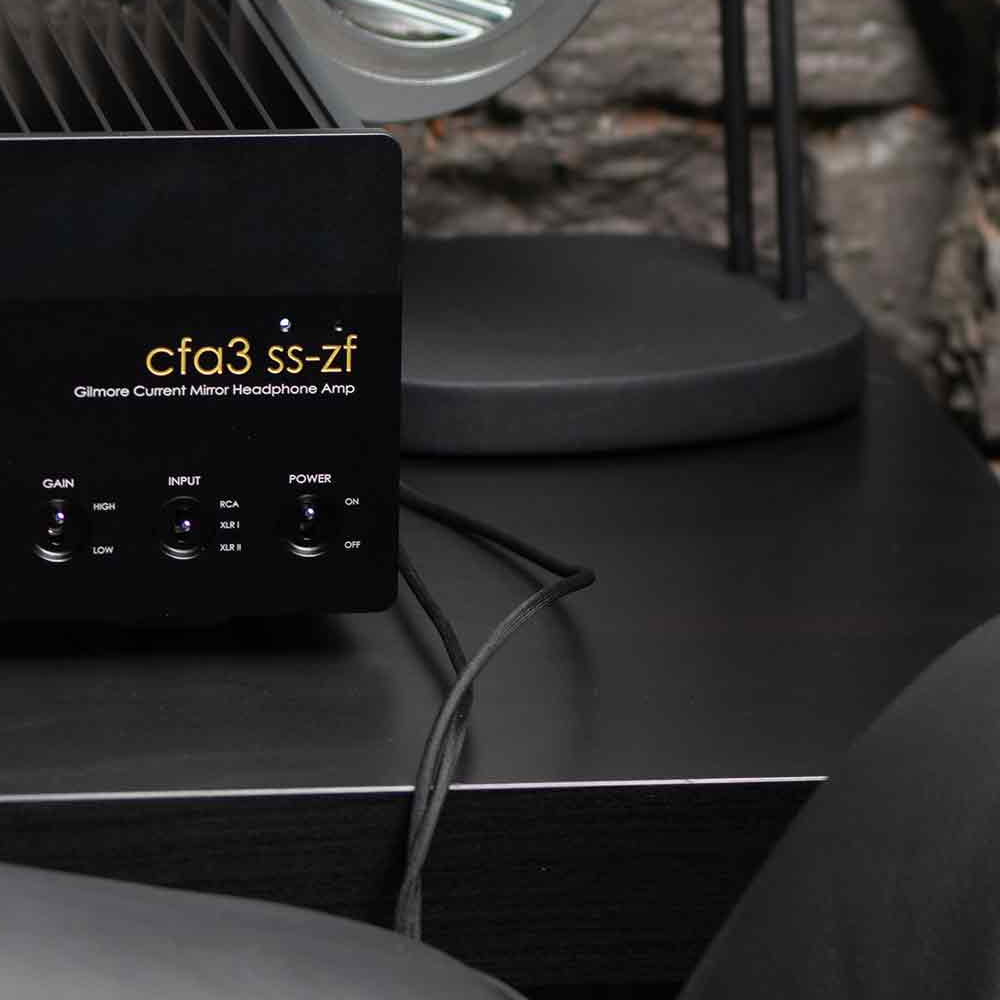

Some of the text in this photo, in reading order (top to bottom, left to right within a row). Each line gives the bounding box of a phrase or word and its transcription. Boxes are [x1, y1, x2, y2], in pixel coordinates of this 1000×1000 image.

[145, 333, 358, 377] cfa3 ss-zf
[73, 383, 356, 399] Gilmore Current Mirror Headphone Amp
[42, 478, 75, 489] GAIN
[168, 475, 201, 487] INPUT
[288, 473, 332, 484] POWER
[92, 501, 116, 511] HIGH
[219, 499, 240, 509] RCA
[344, 497, 360, 506] ON
[219, 520, 235, 529] XLR
[219, 543, 235, 552] XLR
[343, 540, 361, 549] OFF
[92, 545, 114, 555] LOW
